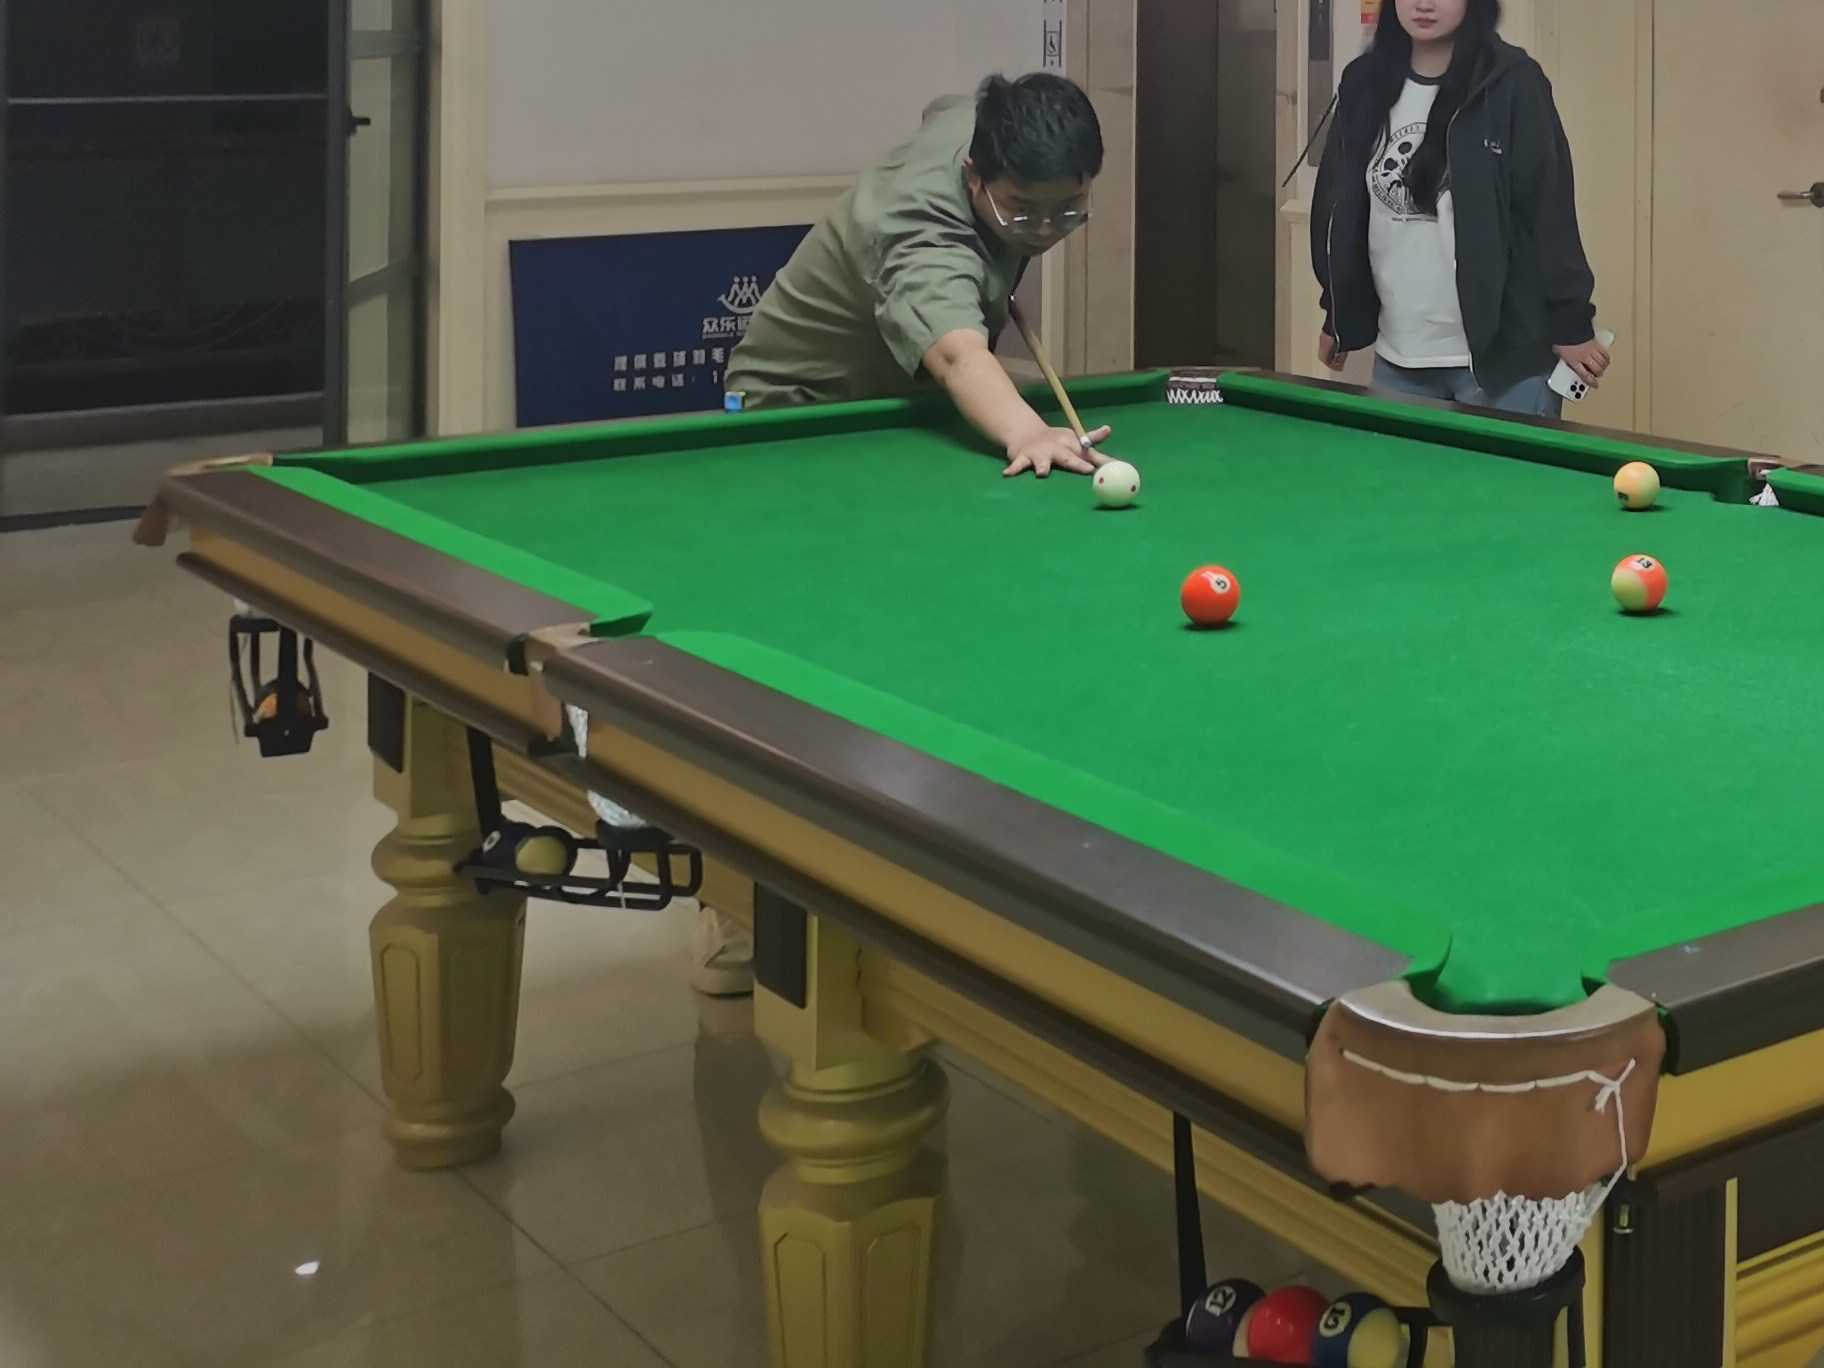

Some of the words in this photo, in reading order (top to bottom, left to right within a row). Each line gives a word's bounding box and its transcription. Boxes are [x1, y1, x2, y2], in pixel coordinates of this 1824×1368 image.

[1635, 557, 1653, 569] 13
[1215, 578, 1228, 590] 5
[1209, 1288, 1233, 1310] 12
